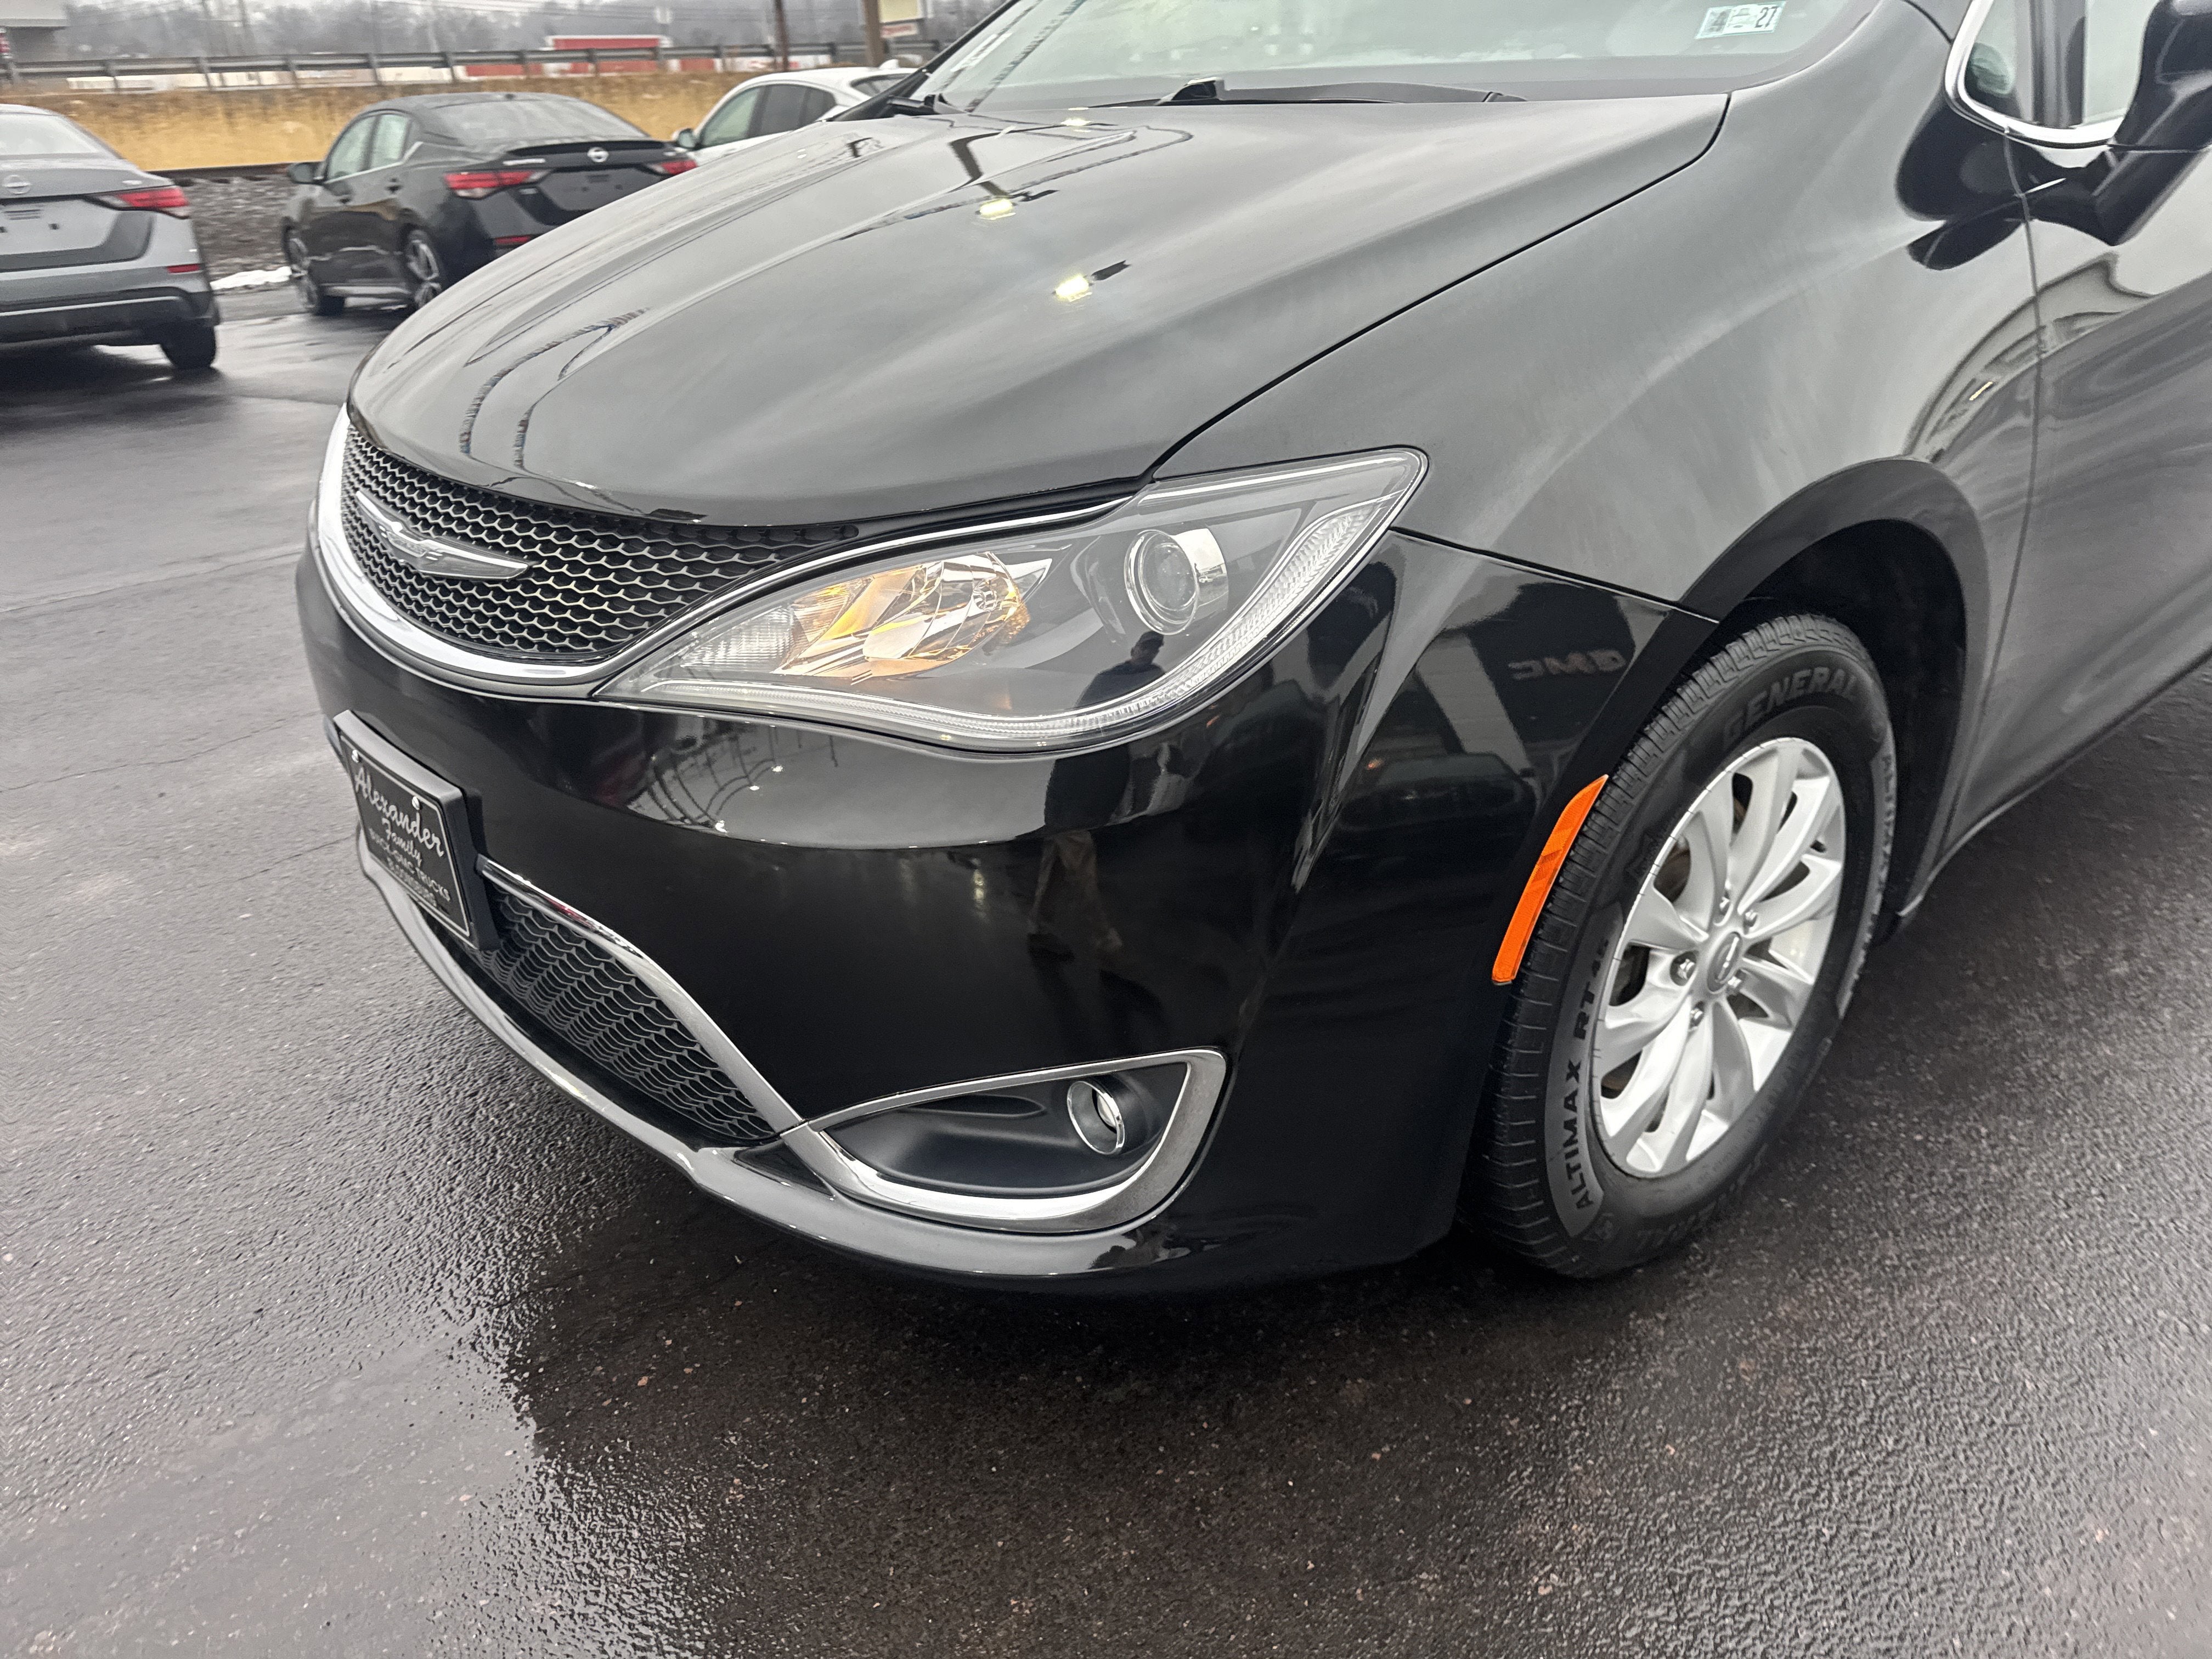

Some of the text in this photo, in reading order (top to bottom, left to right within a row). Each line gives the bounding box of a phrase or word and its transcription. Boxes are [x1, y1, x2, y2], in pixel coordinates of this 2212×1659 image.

[1755, 6, 1779, 28] 27
[1724, 665, 1859, 746] GENERAL
[354, 766, 445, 857] Alexander
[382, 816, 422, 867] Family
[1563, 1059, 1594, 1209] ALTIMAX
